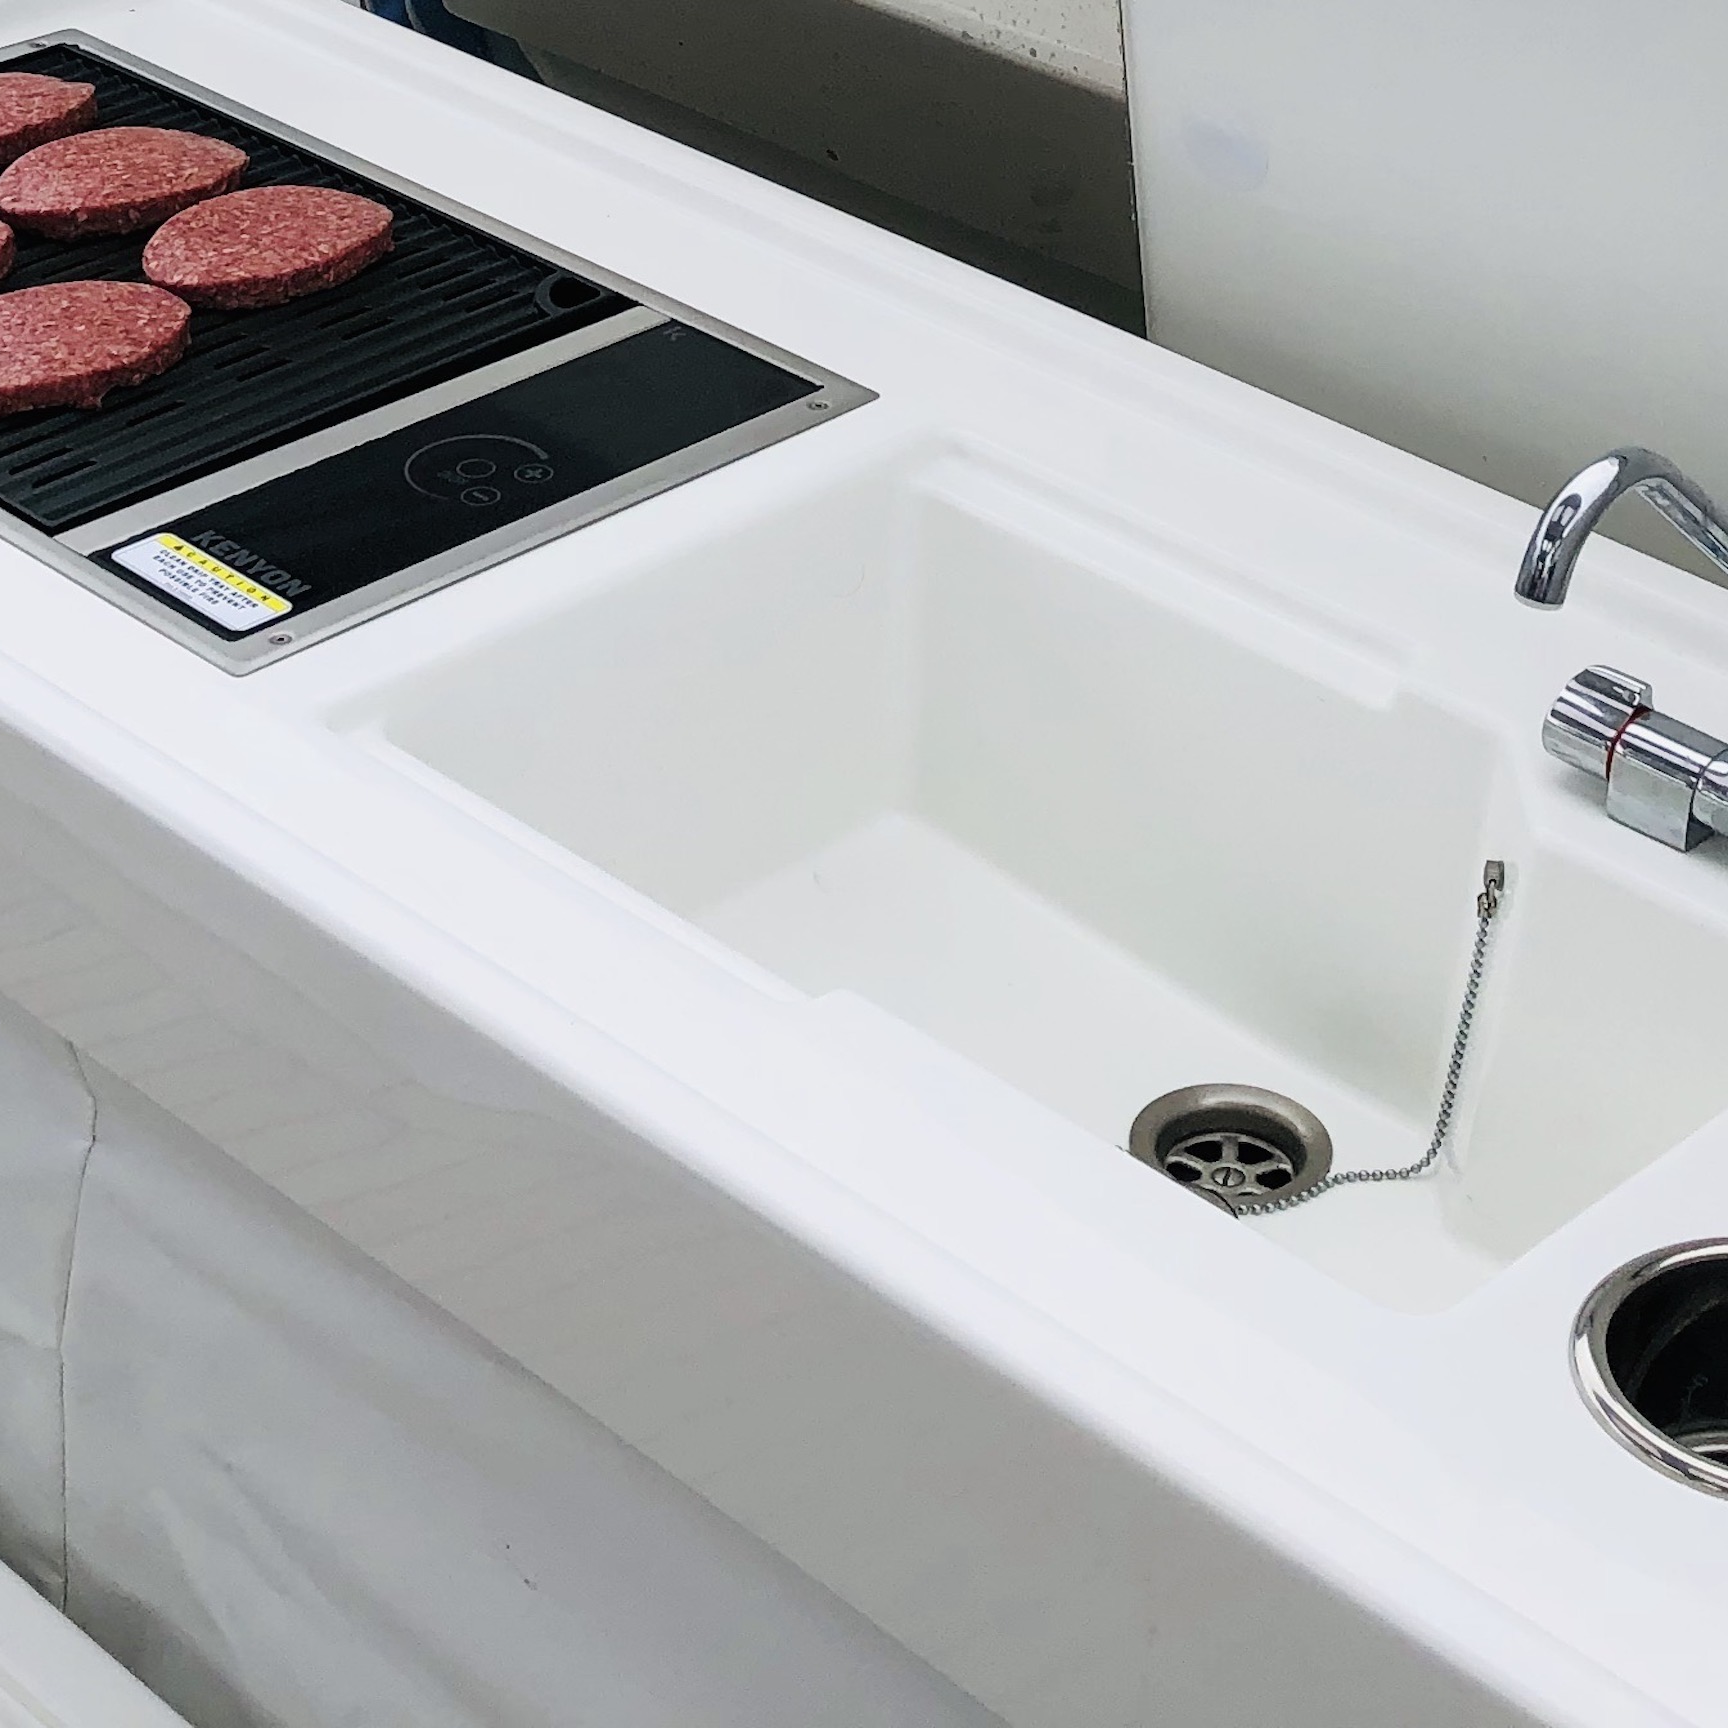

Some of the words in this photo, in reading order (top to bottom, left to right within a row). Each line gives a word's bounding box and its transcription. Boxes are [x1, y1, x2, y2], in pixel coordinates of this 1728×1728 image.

[153, 555, 175, 570] EACH
[176, 567, 195, 581] USE
[196, 578, 207, 587] TO
[207, 586, 247, 611] PREVENT
[158, 568, 199, 593] POSSIBLE
[199, 591, 220, 606] FIRE
[160, 549, 187, 568] CLEAN
[188, 563, 209, 579] DRIP
[209, 576, 230, 592] TRAY
[231, 591, 259, 608] AFTER
[186, 551, 271, 601] CAUTION
[192, 530, 312, 597] KENYON
